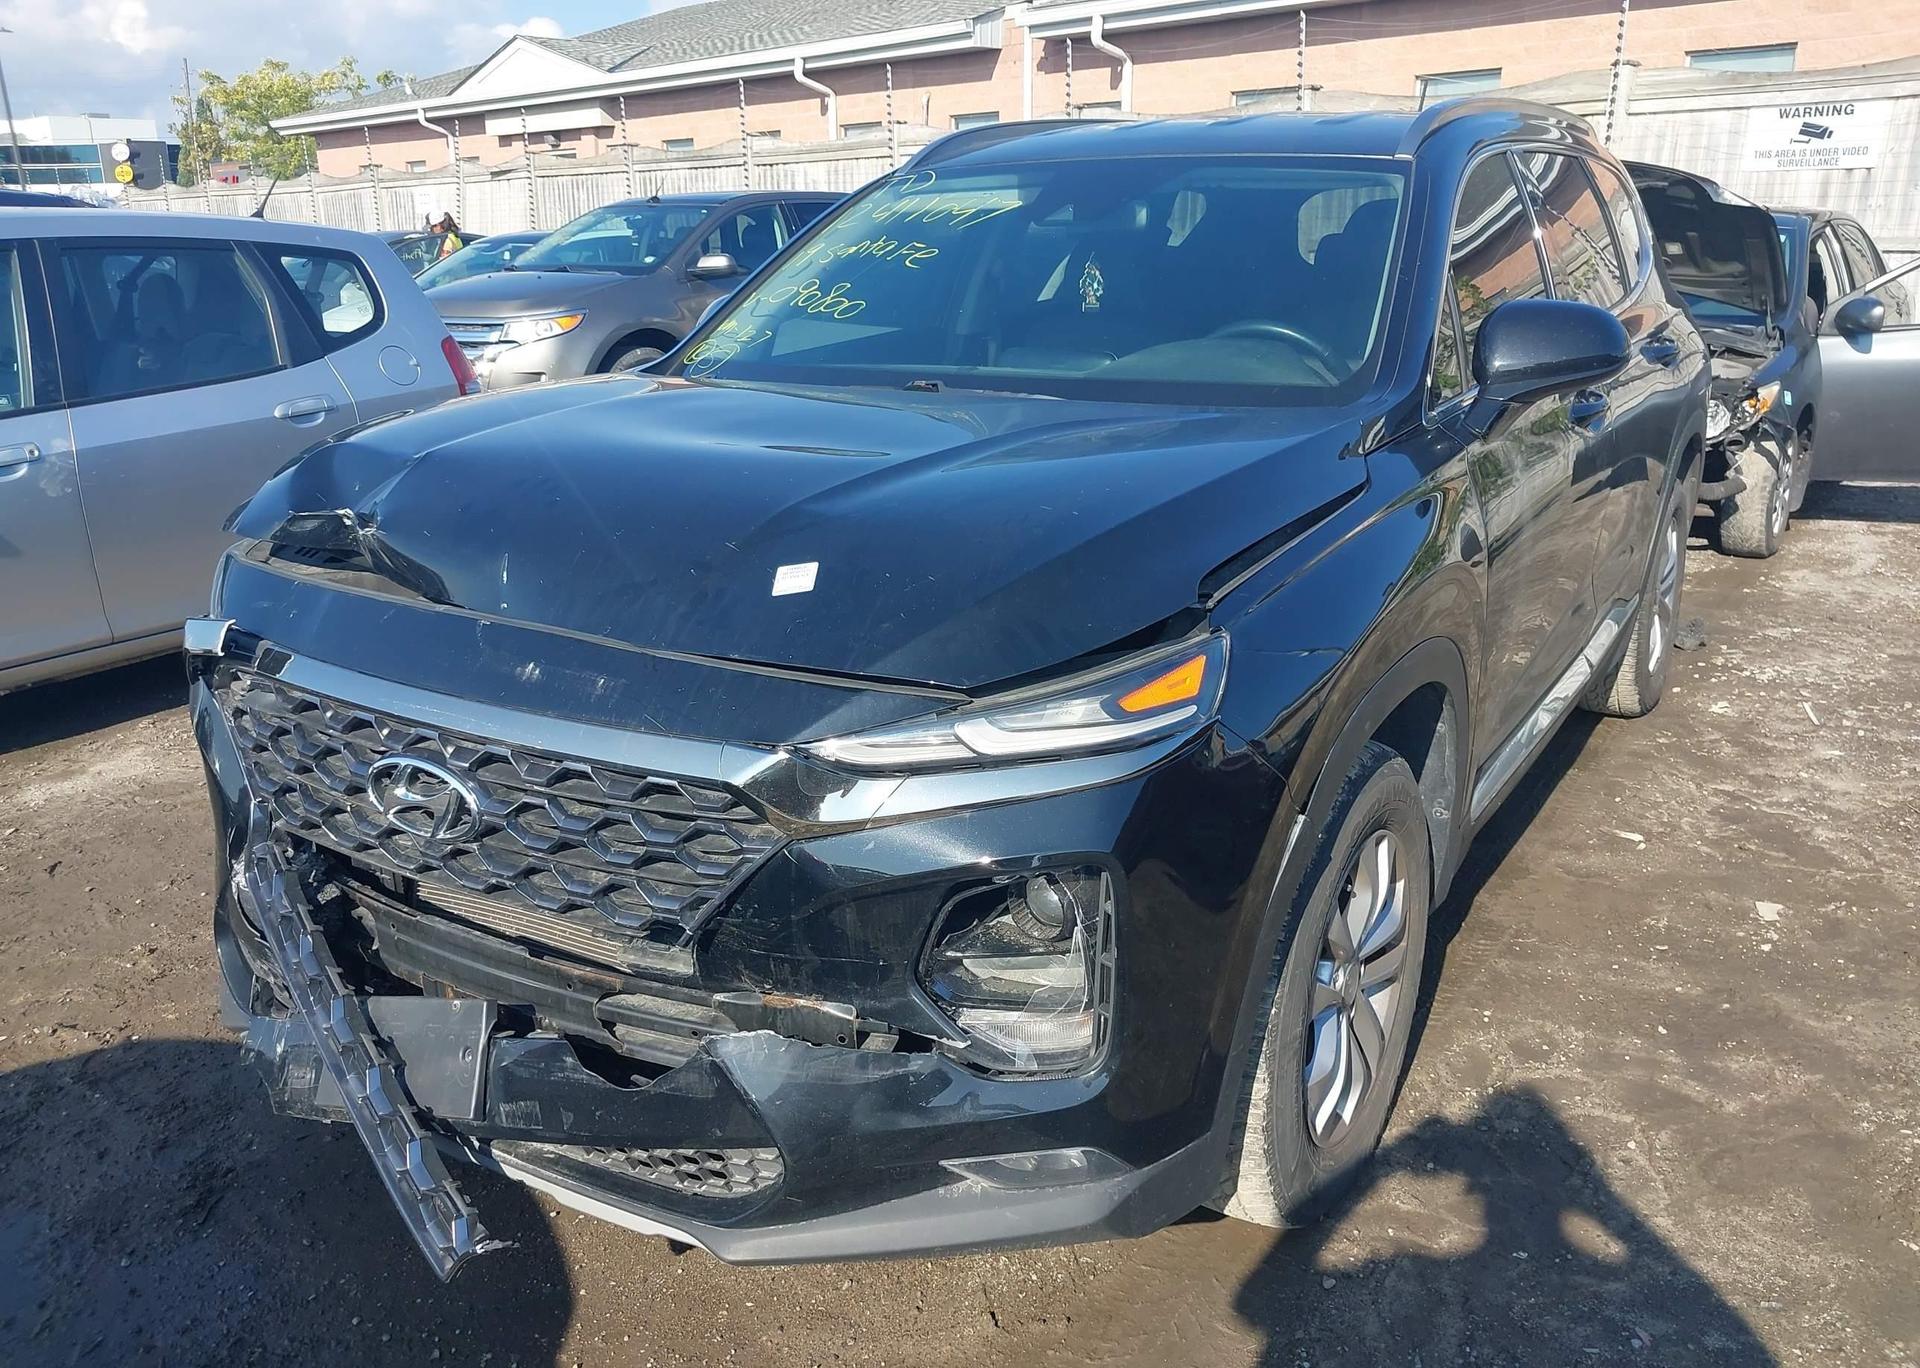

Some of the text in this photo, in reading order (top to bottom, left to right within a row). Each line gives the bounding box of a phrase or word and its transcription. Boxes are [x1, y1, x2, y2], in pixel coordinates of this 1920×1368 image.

[1779, 103, 1855, 119] WARNING
[1754, 146, 1869, 159] THIS AREA IS UNDER VIDEO
[1777, 157, 1840, 168] SURVEILLANCE
